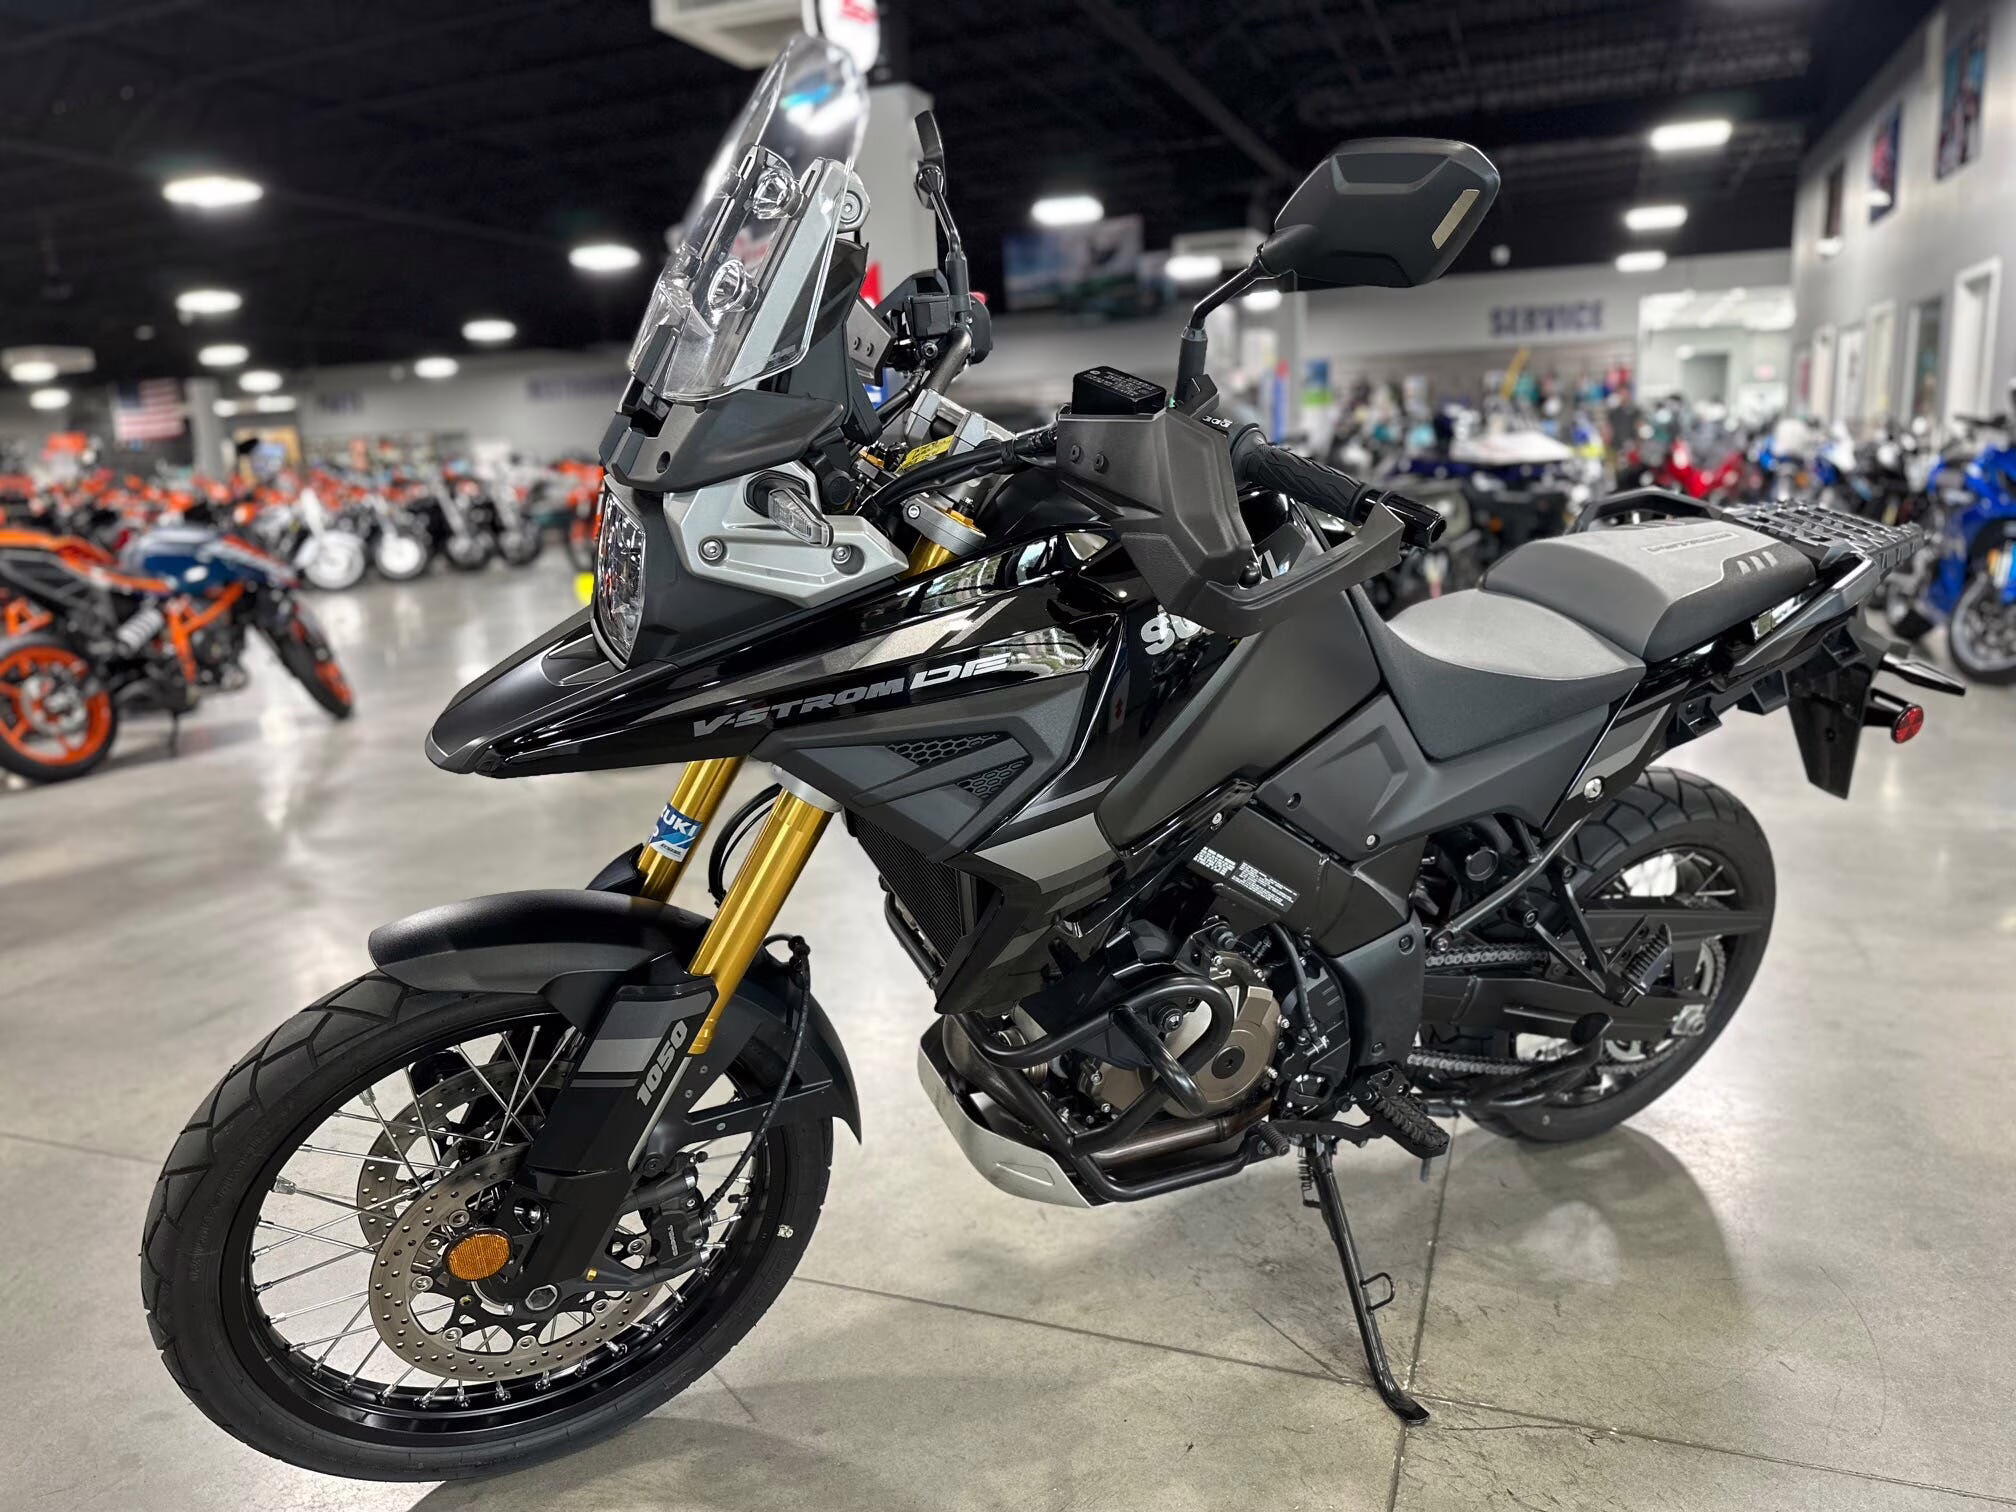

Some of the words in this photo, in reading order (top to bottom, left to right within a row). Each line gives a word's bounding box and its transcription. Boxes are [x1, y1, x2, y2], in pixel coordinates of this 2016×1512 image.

[1490, 300, 1603, 337] SERVICE
[693, 678, 905, 737] V-STROM
[910, 652, 1012, 690] DE
[661, 805, 698, 837] UKI
[636, 1020, 688, 1106] 1050
